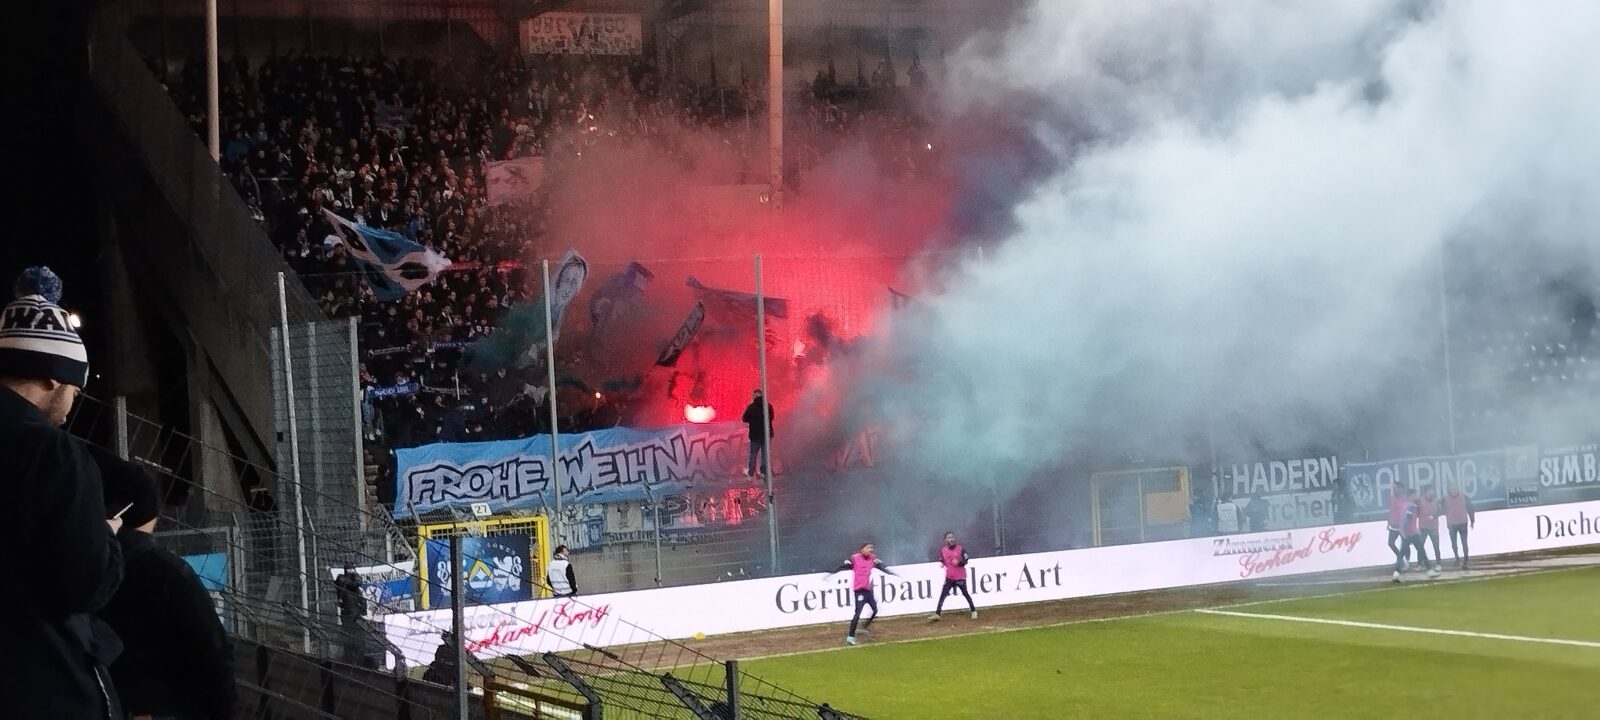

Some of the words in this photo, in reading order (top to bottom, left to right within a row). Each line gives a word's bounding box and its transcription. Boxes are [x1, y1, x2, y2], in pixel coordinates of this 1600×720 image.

[3, 306, 72, 331] WA
[408, 457, 549, 505] FROHE
[559, 433, 748, 499] WEIHNAC
[1540, 452, 1600, 487] SIMB
[475, 505, 487, 514] 27
[1266, 493, 1334, 521] rchen
[1239, 536, 1316, 578] Gerhard
[775, 575, 932, 614] Gerütbau
[948, 566, 1007, 596] ler
[1015, 562, 1062, 591] Art
[464, 610, 548, 653] erhard
